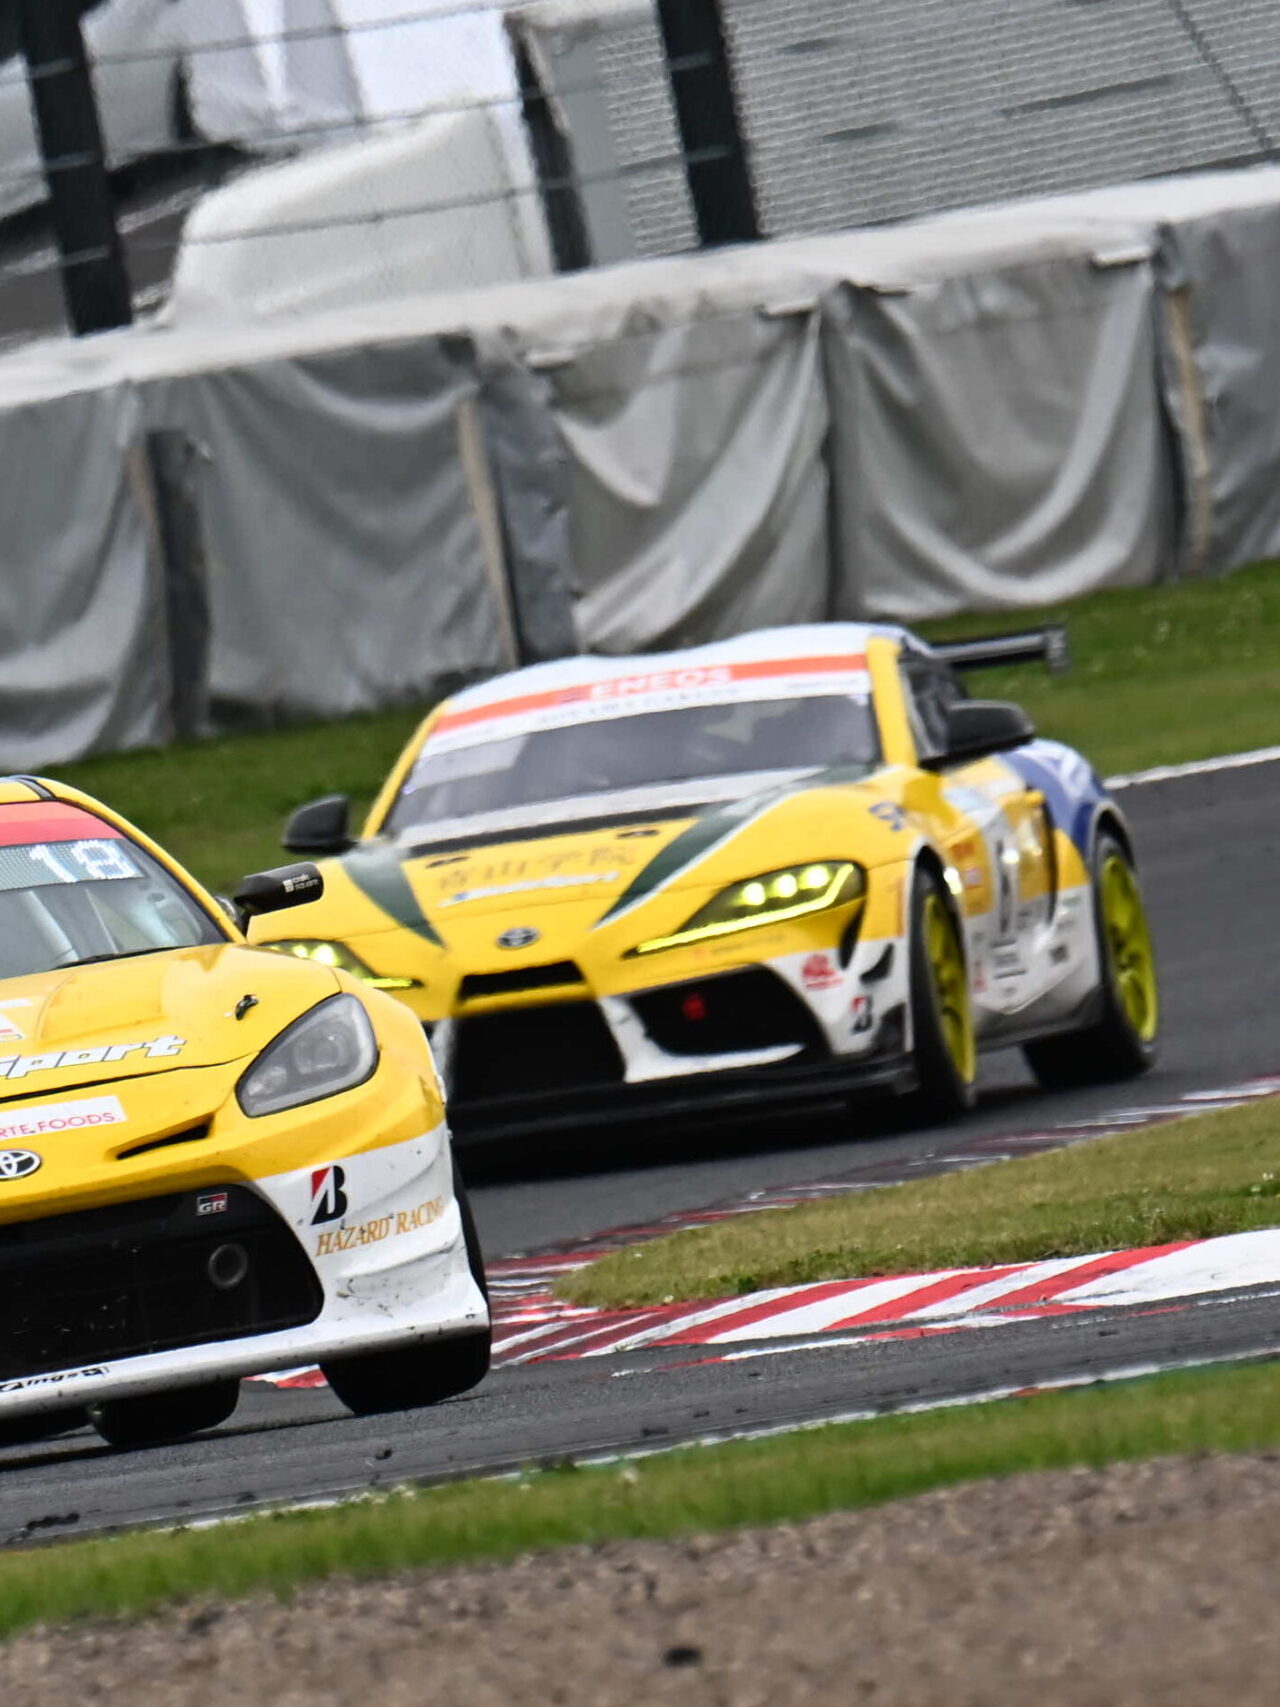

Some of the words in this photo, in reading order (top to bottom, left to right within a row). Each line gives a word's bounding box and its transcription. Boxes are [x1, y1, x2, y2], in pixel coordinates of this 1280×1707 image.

[588, 668, 732, 698] ENEOS
[30, 838, 137, 884] 18
[197, 1199, 227, 1215] GR
[315, 1219, 392, 1257] HAZARD
[396, 1195, 445, 1236] RACING
